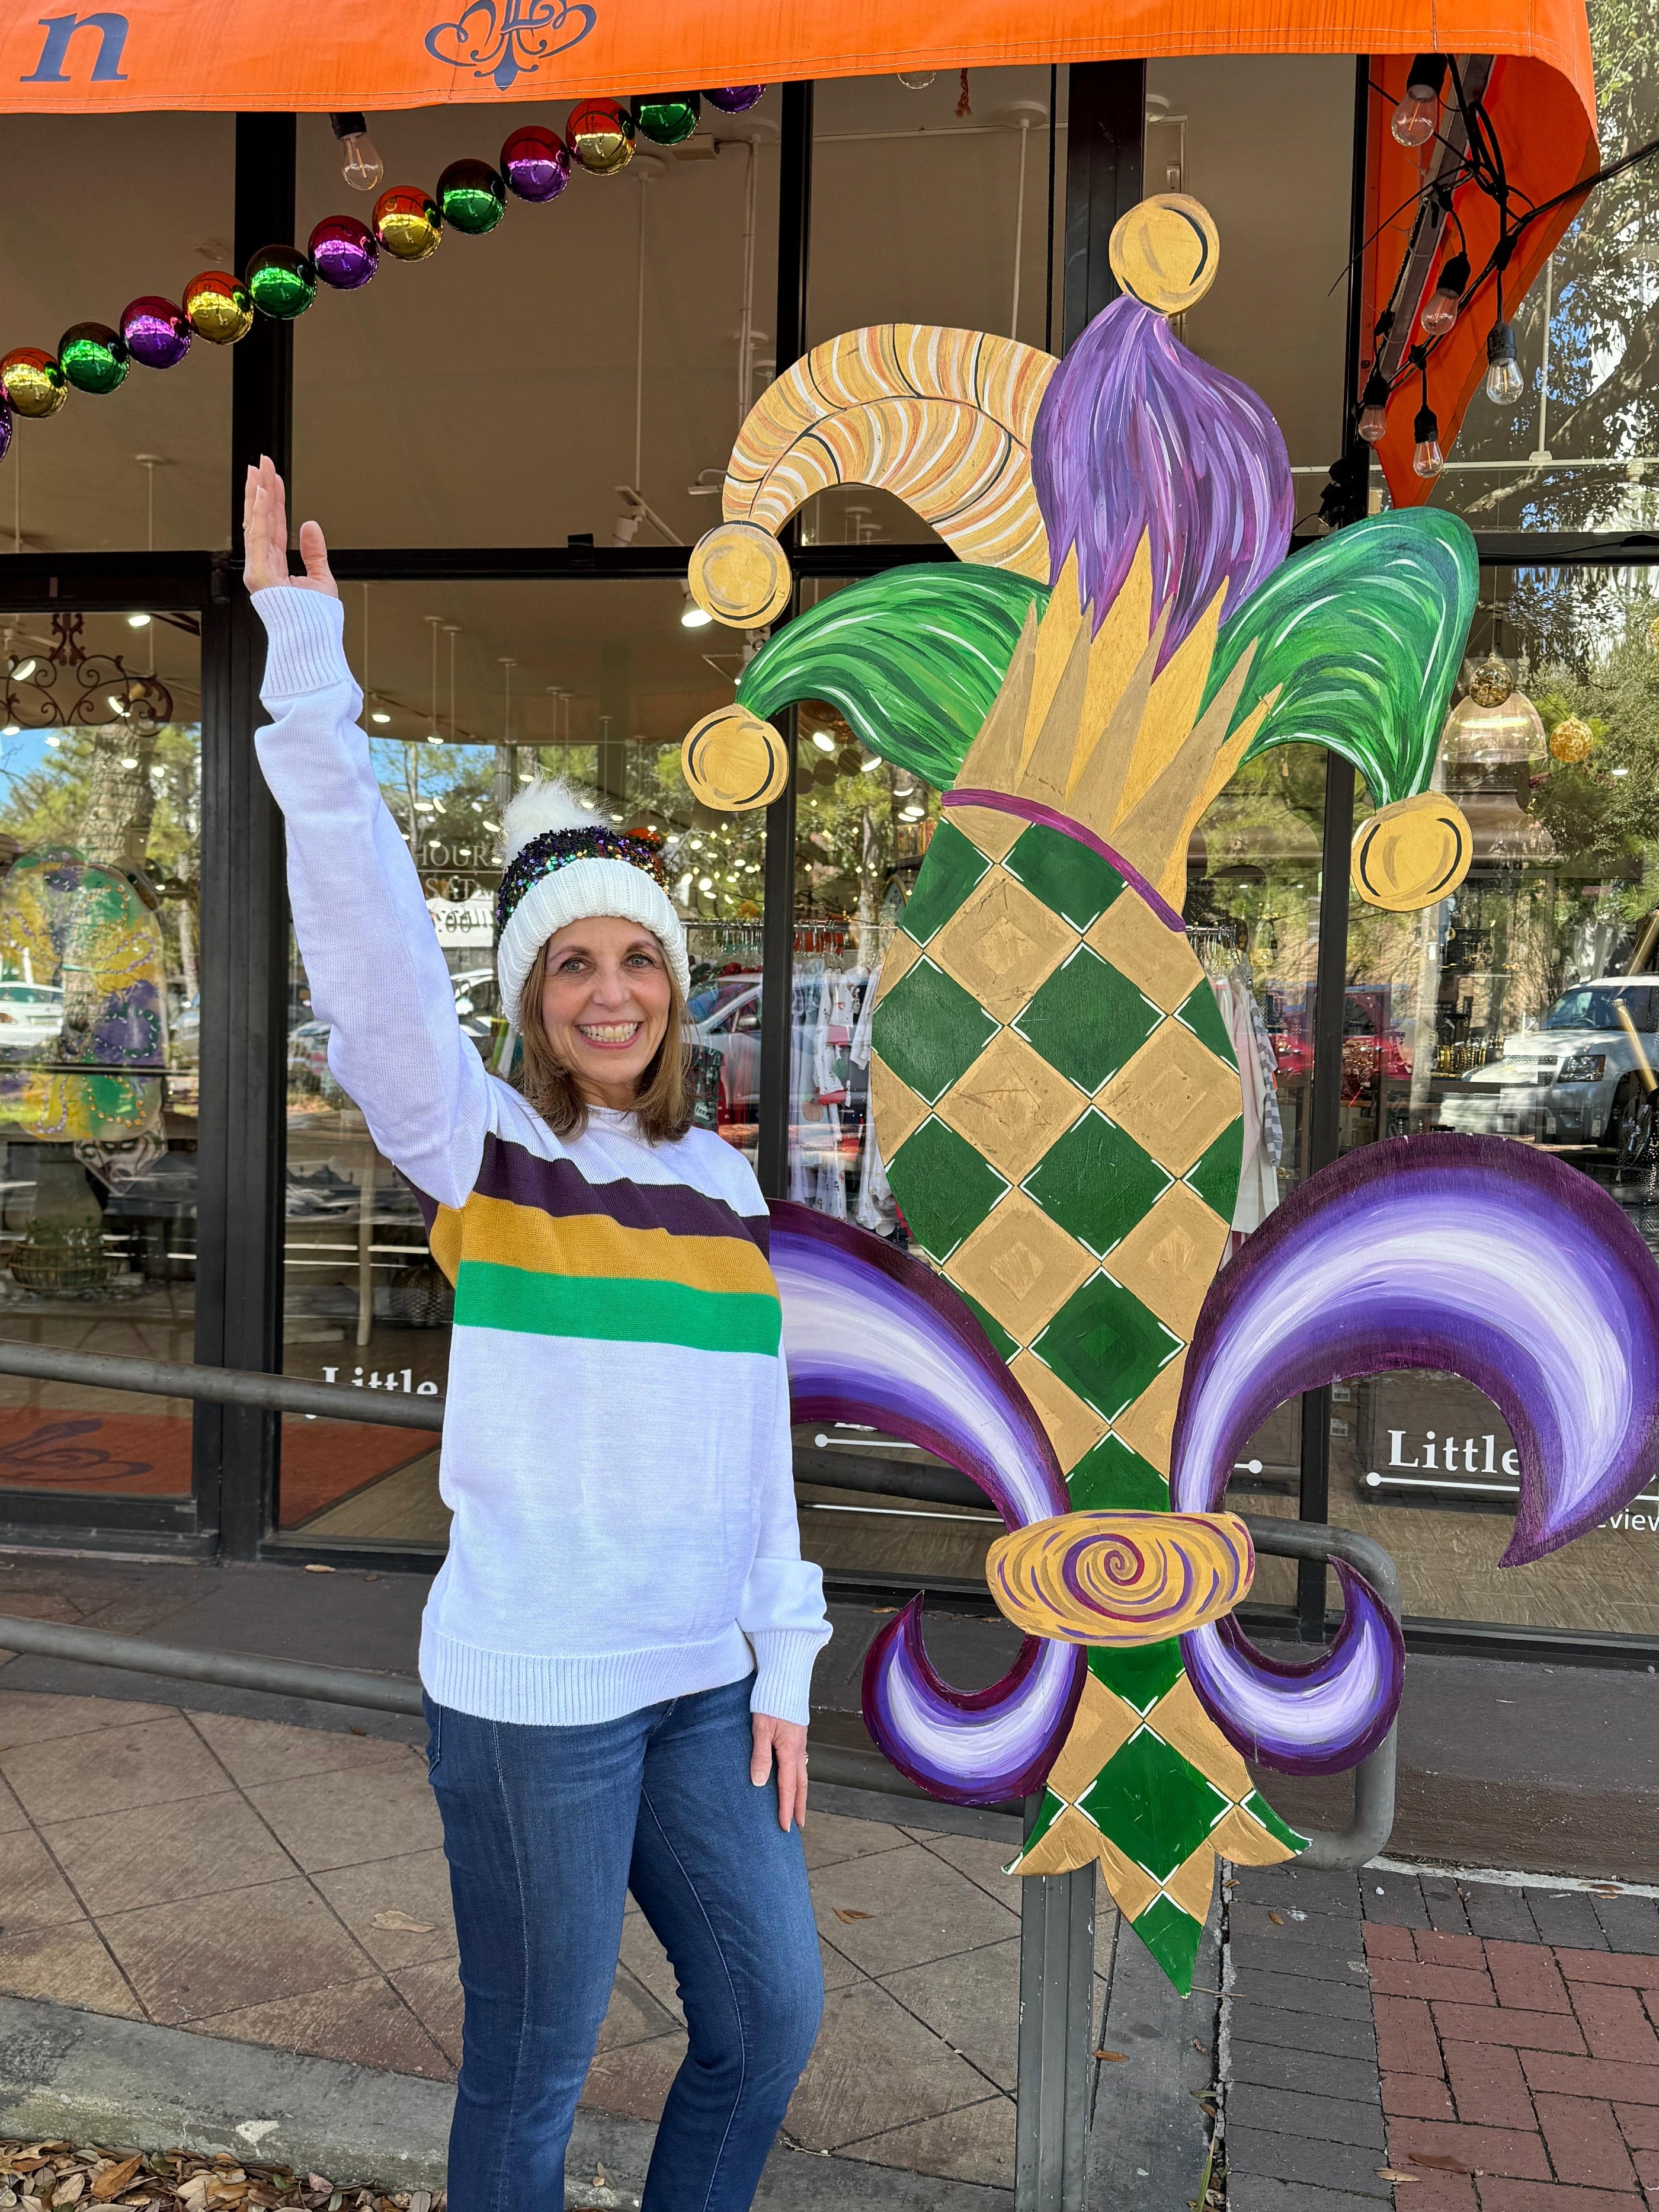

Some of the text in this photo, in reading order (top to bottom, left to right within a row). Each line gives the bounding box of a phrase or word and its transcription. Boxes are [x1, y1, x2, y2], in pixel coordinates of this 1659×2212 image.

[20, 12, 129, 82] n
[411, 844, 502, 867] HOUR
[1387, 1429, 1520, 1475] Little
